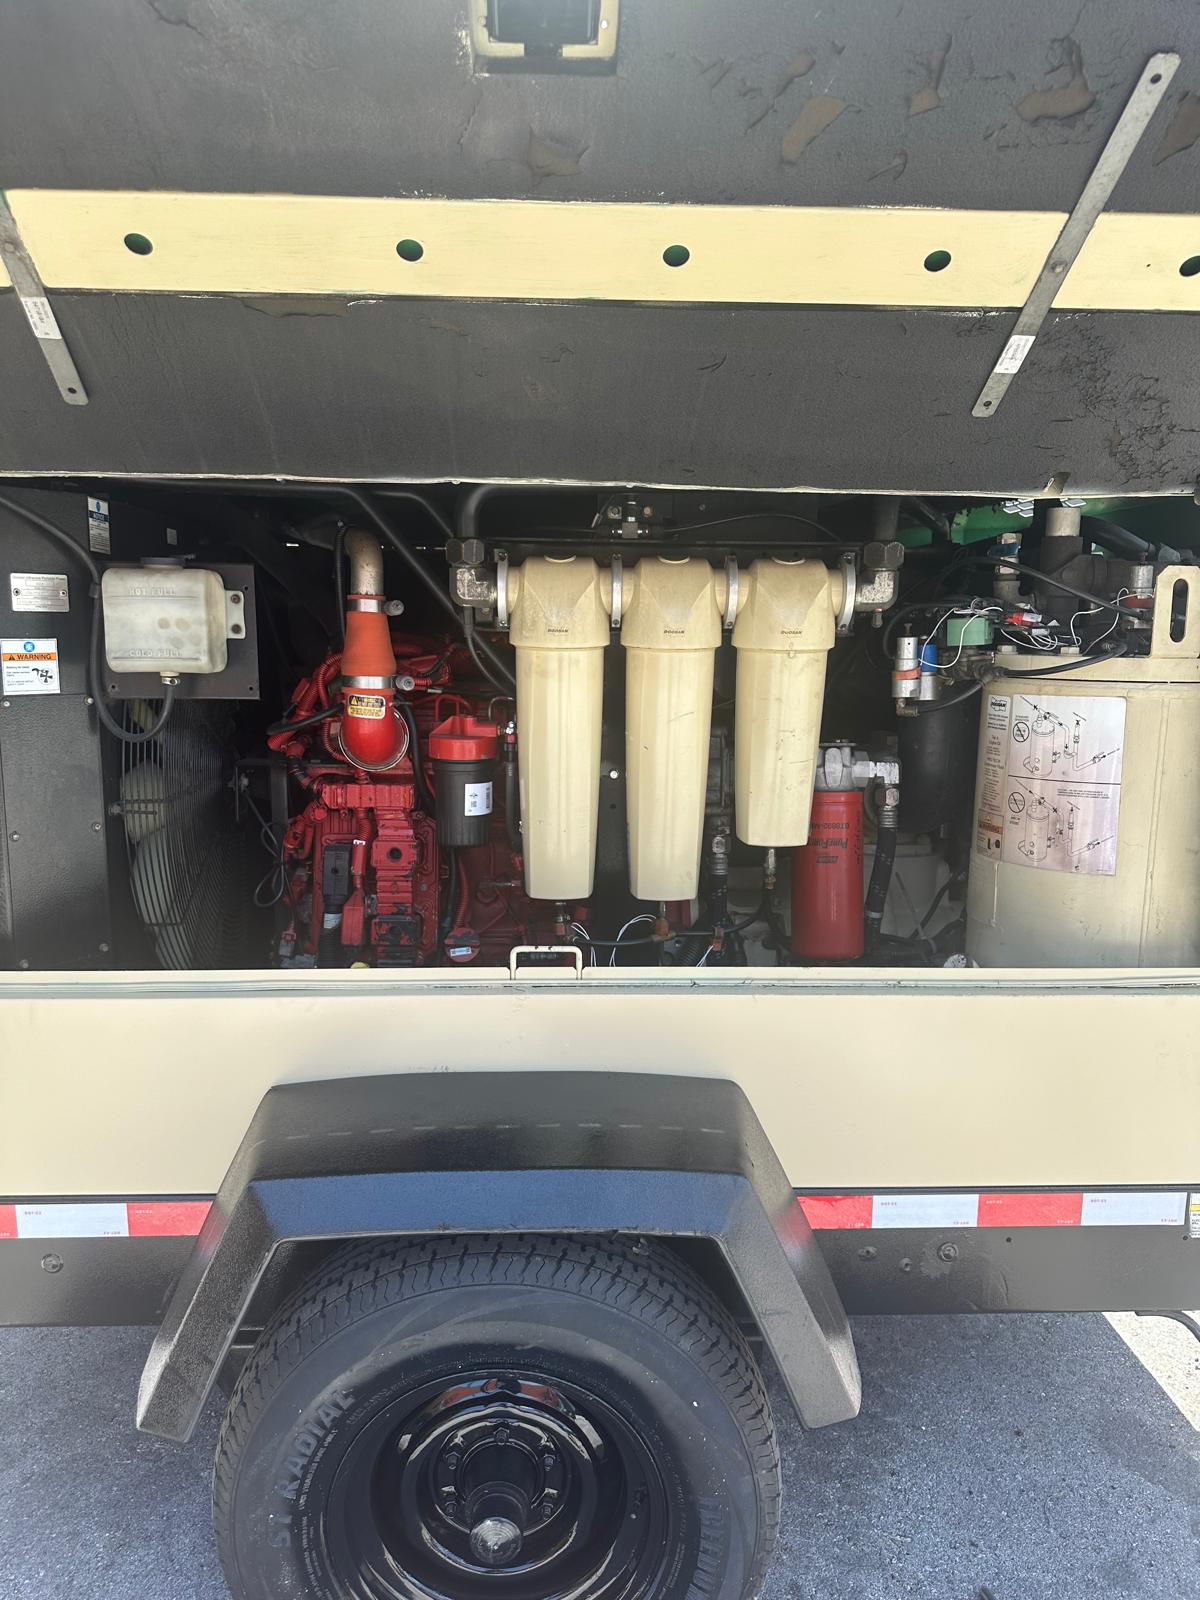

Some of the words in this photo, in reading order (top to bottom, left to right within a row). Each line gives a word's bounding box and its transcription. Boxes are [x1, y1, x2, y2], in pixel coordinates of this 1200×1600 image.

[151, 587, 176, 596] FULL
[17, 653, 52, 661] WARNING
[129, 649, 153, 657] COLD
[158, 649, 182, 657] FULL
[275, 1388, 355, 1500] RADIAL
